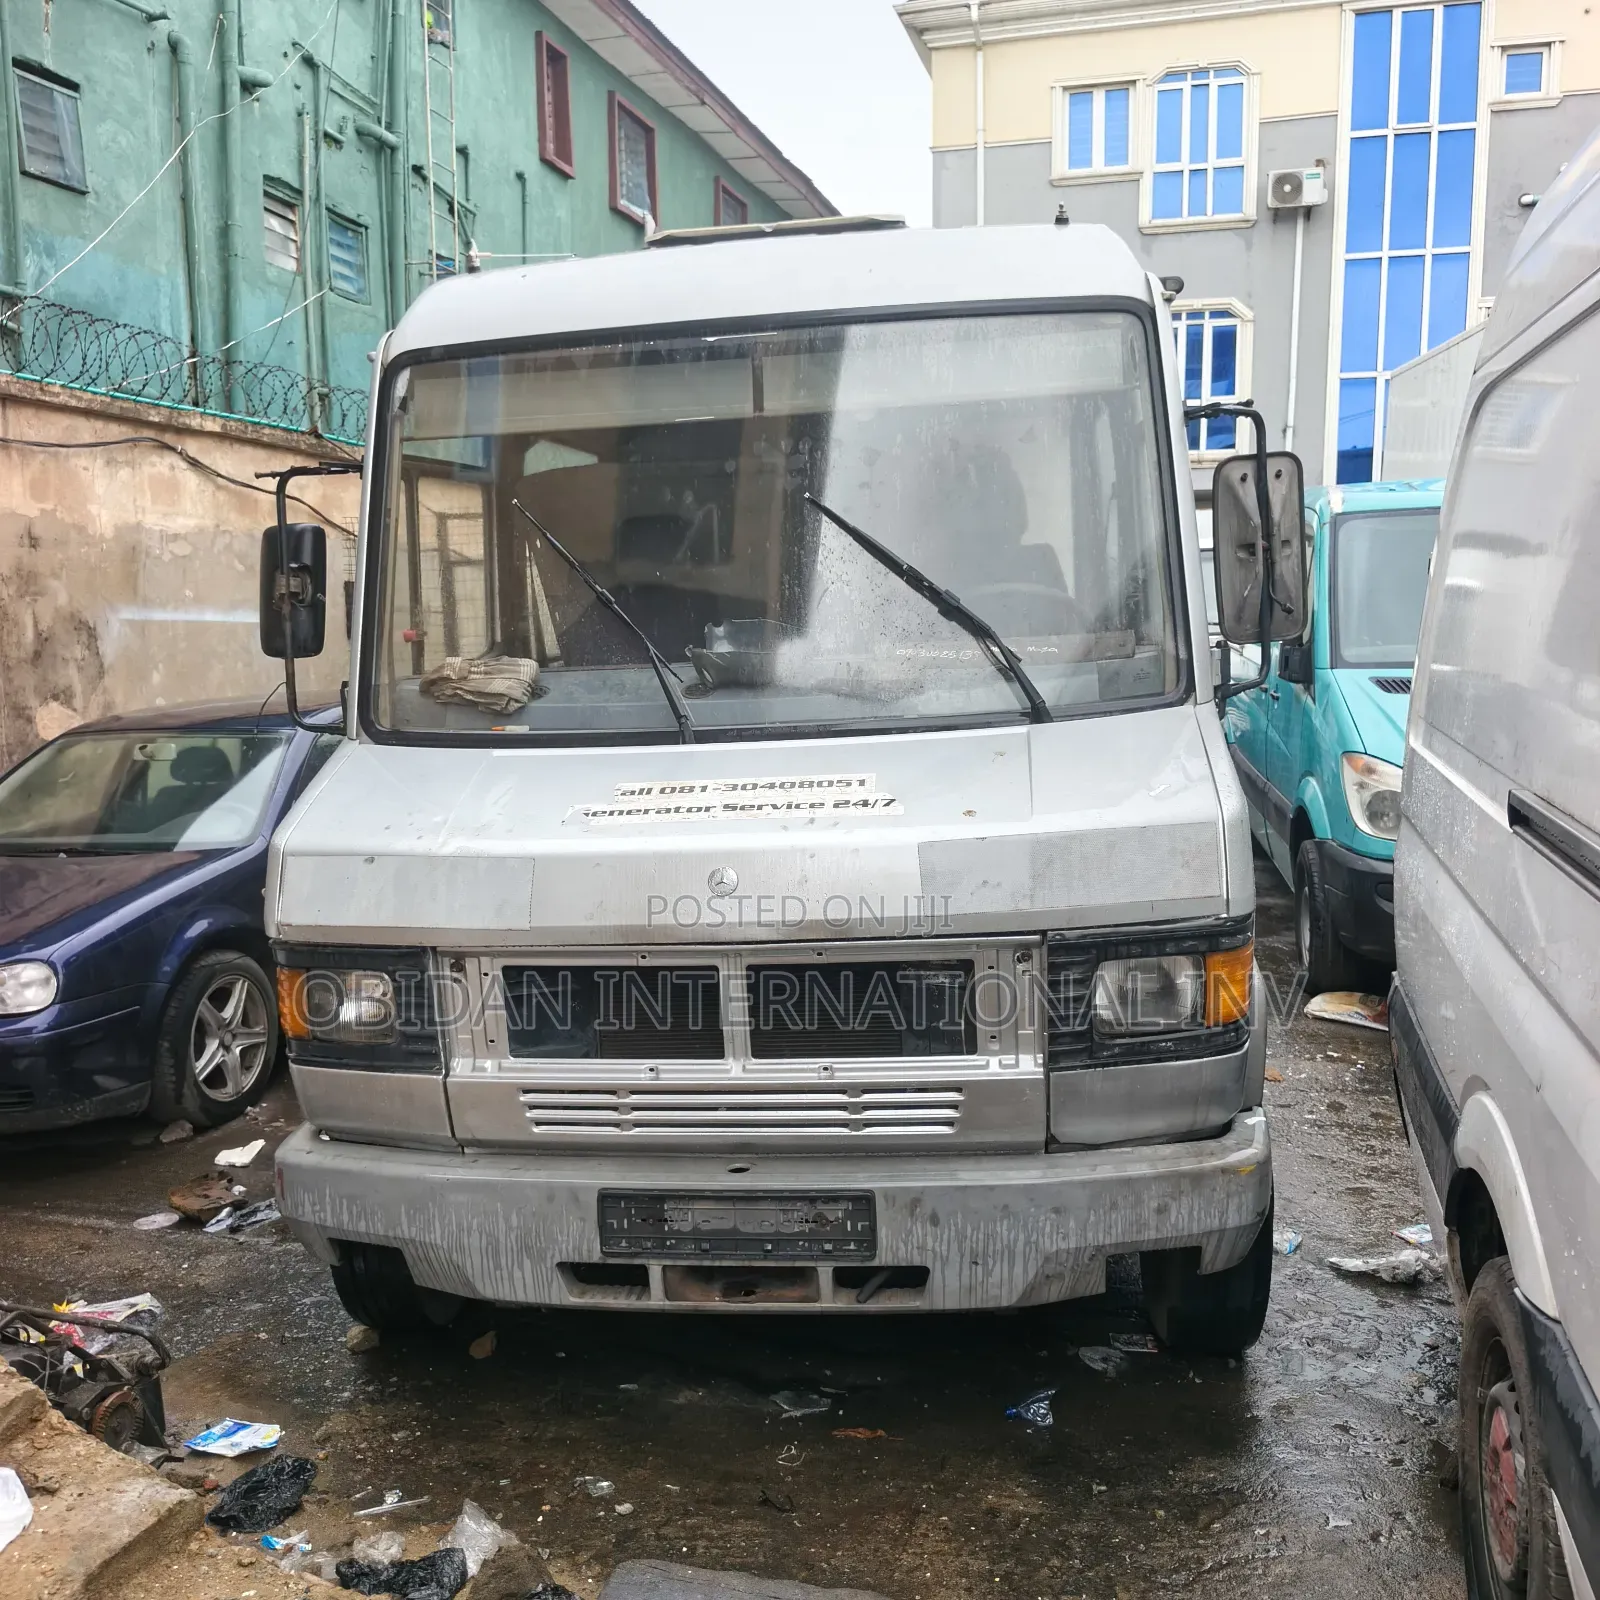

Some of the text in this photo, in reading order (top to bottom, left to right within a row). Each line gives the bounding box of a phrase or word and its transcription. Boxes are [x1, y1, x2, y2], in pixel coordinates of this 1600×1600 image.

[614, 786, 653, 797] all
[721, 801, 826, 812] Service
[832, 798, 897, 809] 24/7
